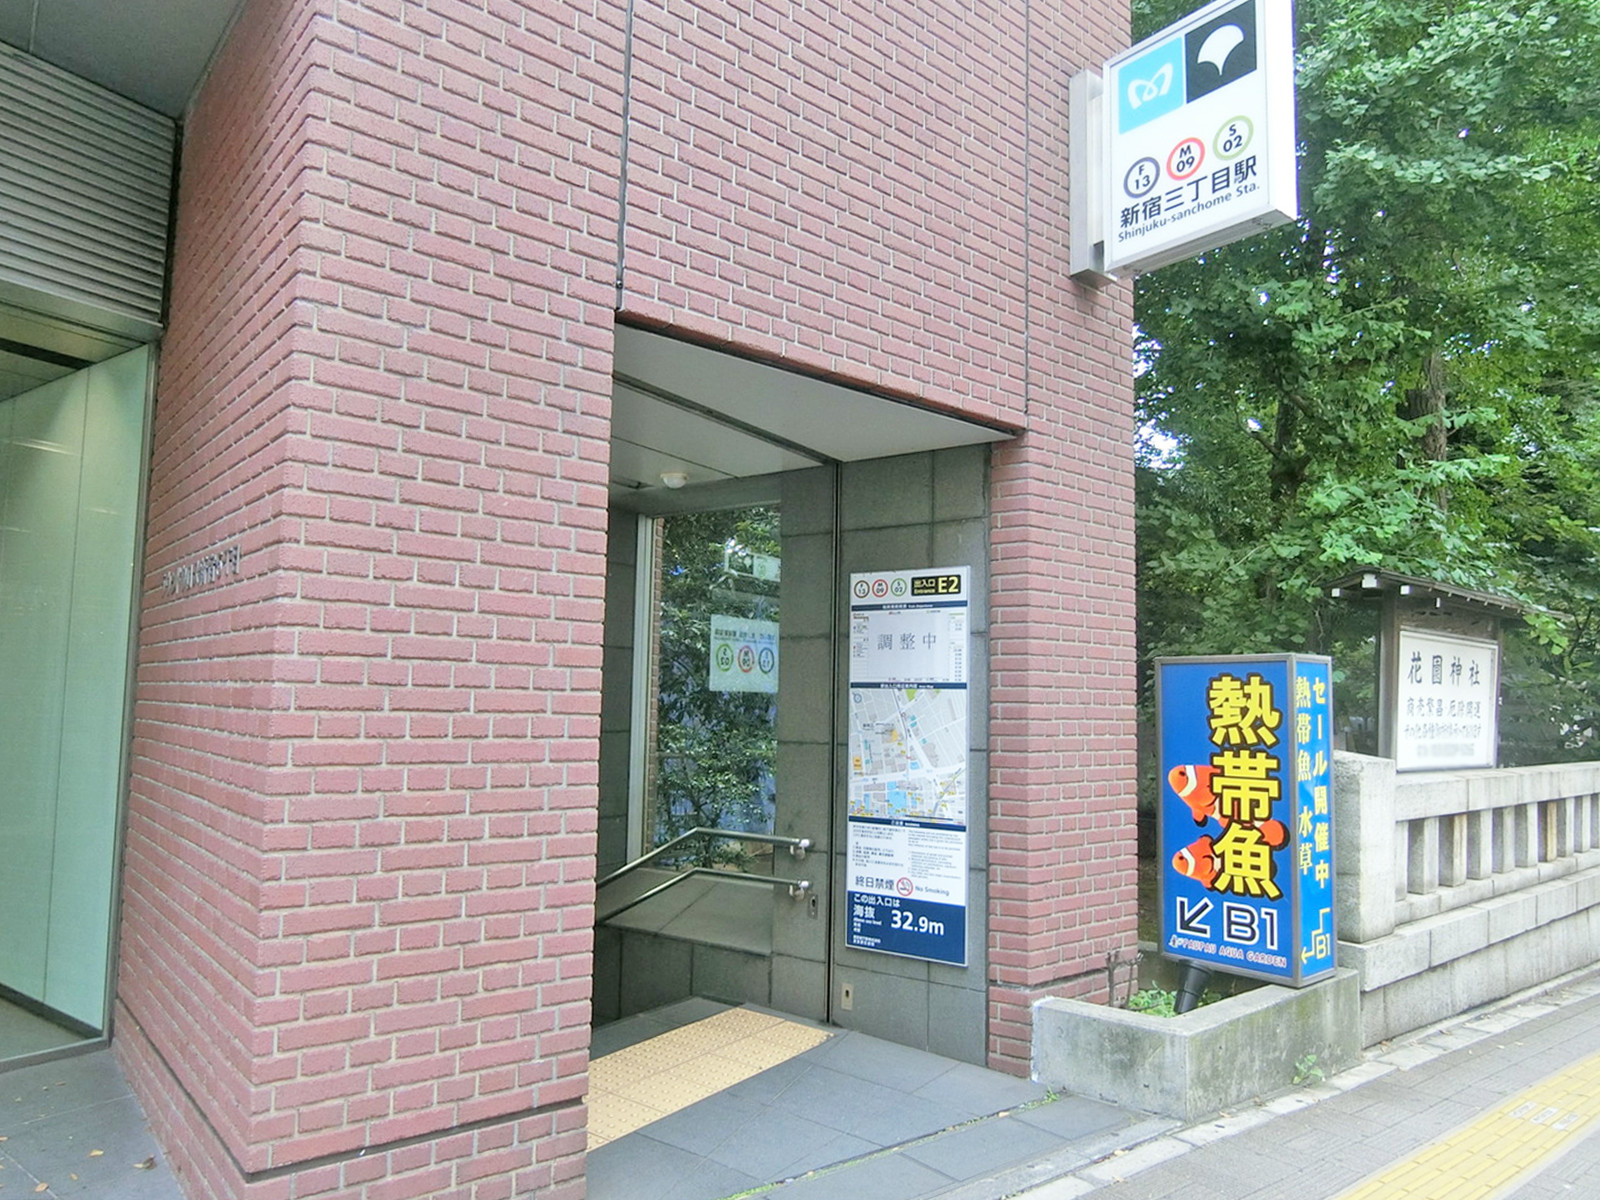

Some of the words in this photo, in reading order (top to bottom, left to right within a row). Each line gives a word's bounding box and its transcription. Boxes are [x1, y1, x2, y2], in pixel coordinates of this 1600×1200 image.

[1229, 124, 1237, 137] S
[1179, 145, 1192, 159] M
[1223, 135, 1243, 153] 02
[1138, 164, 1145, 176] F
[1176, 156, 1195, 173] 09
[1119, 155, 1257, 229] 新宿三丁目駅
[1134, 175, 1151, 190] 13
[1118, 191, 1232, 243] Shinjuku-sanchome
[1236, 182, 1260, 198] Sta.
[938, 576, 959, 593] E2
[877, 632, 937, 650] 調整中
[1407, 651, 1481, 687] 花園神社
[1295, 676, 1311, 781] 熱帯魚
[1207, 672, 1284, 900] 熱帯魚
[1312, 676, 1330, 889] セール開催中
[1298, 805, 1312, 876] 水草
[855, 876, 895, 891] 終日禁煙
[925, 886, 950, 897] Smoking
[853, 893, 900, 908] この出入口は
[891, 909, 944, 936] 32.9m
[1223, 901, 1278, 950] B1
[1315, 933, 1331, 959] B1
[1219, 945, 1244, 960] AQUA
[1246, 951, 1287, 968] GARDEN
